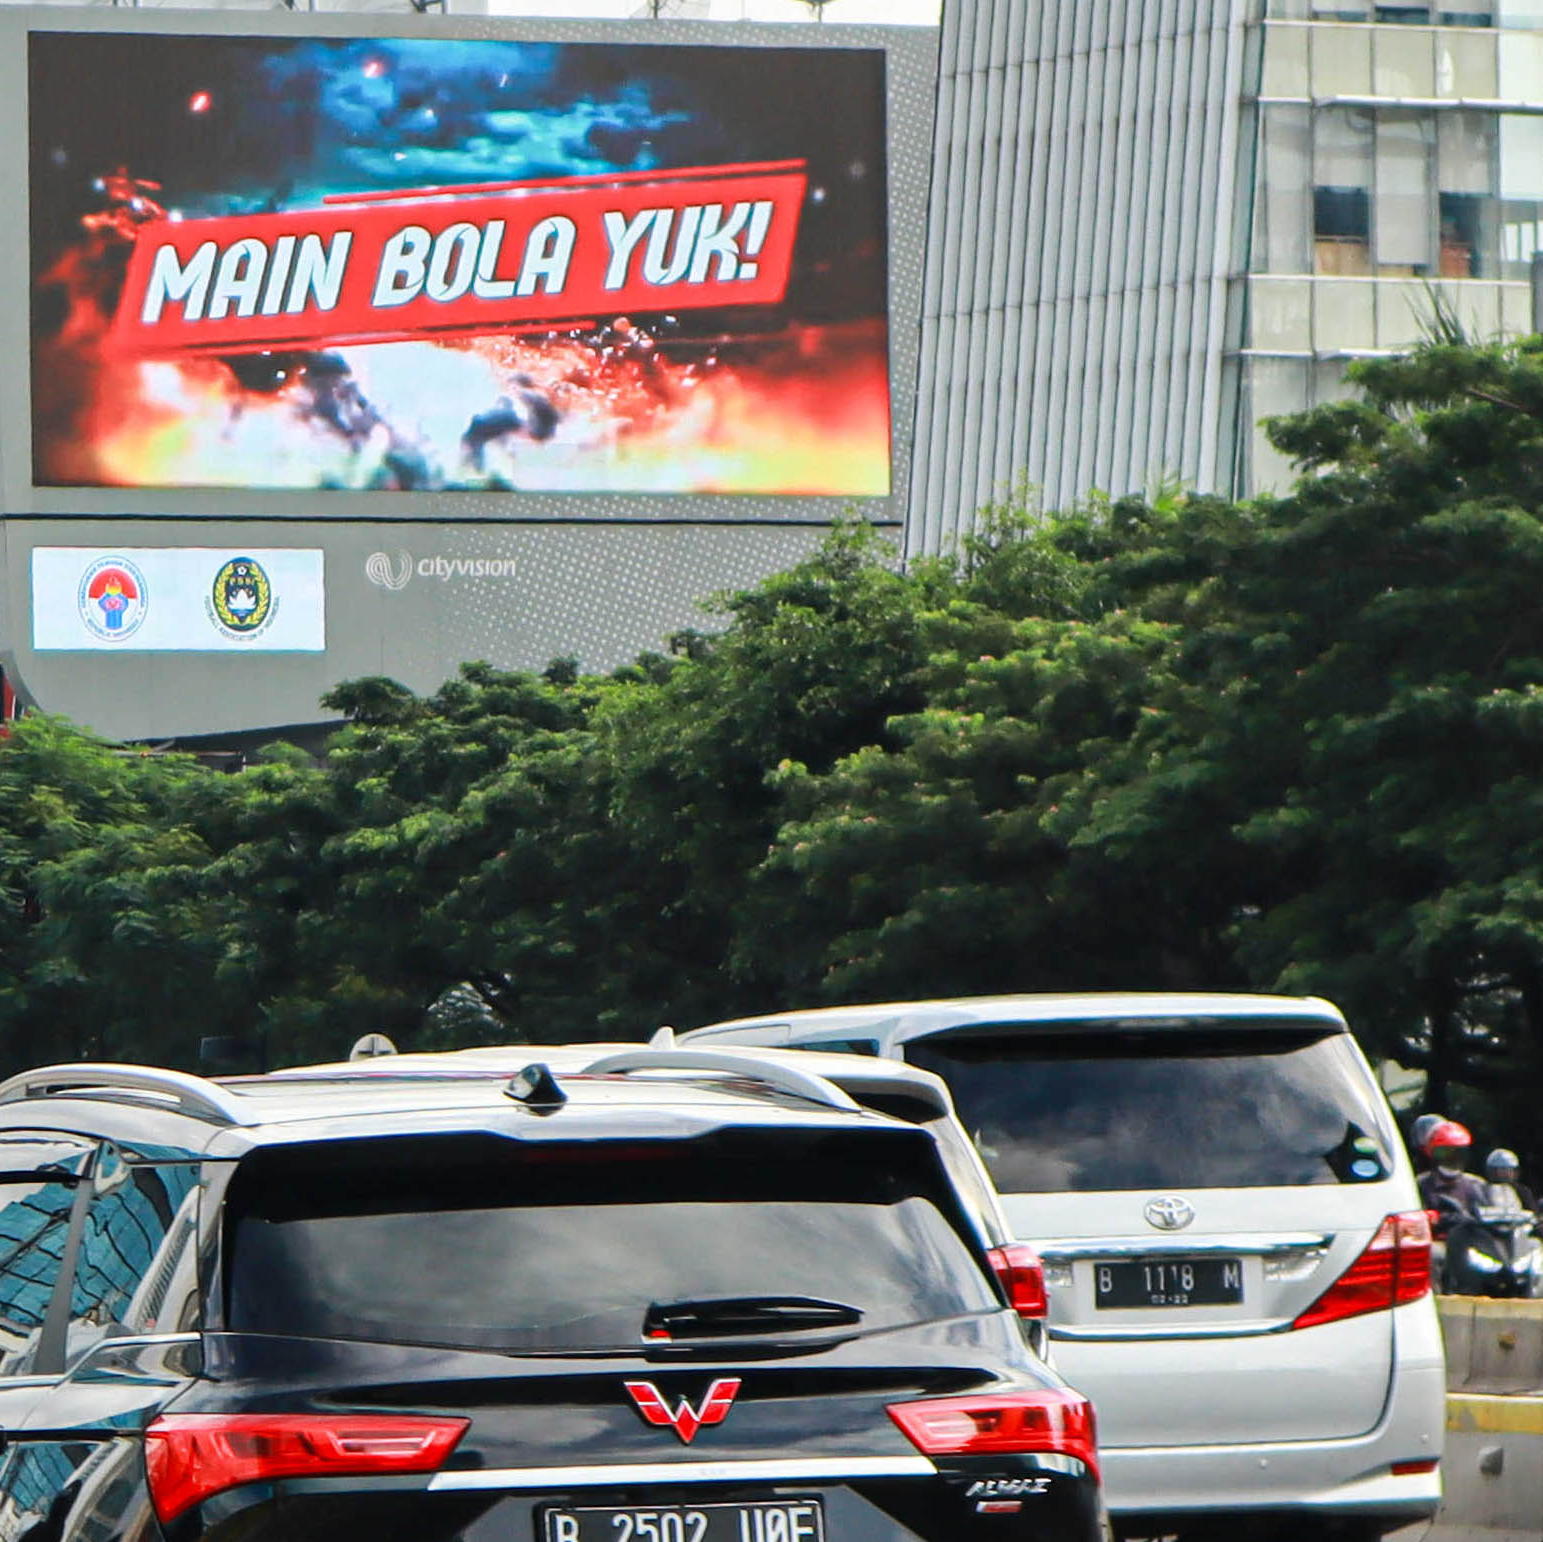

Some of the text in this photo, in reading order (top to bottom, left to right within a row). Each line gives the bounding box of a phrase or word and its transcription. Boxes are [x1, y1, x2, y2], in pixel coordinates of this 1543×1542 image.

[141, 200, 773, 325] MAIN BOLA YUK!
[417, 555, 516, 582] cityvision
[1098, 1266, 1113, 1293] B
[1223, 1263, 1240, 1289] M
